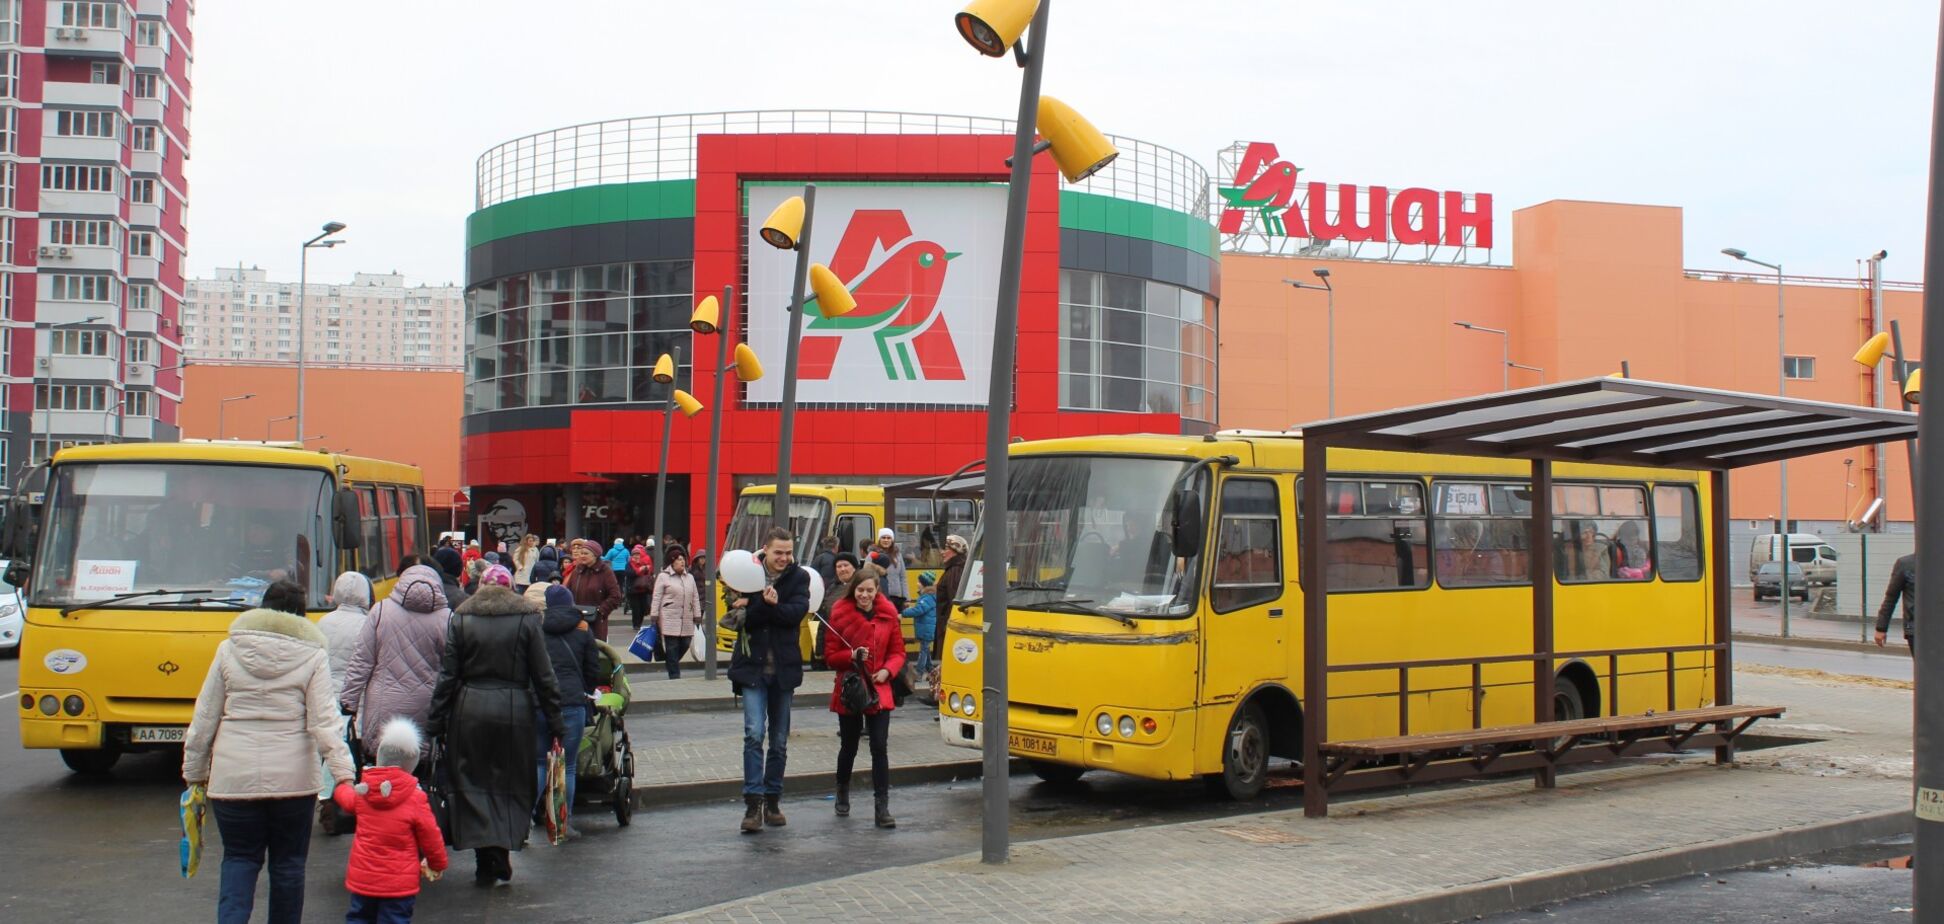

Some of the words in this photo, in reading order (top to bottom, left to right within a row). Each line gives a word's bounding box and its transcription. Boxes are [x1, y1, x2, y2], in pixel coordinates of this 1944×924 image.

[1218, 141, 1493, 249] Ашан
[582, 505, 609, 519] FC
[89, 564, 121, 575] Ашан
[139, 729, 156, 740] AA
[158, 729, 183, 740] 7089
[1008, 735, 1020, 747] AA
[1022, 737, 1040, 751] 1081
[1041, 740, 1054, 753] AA
